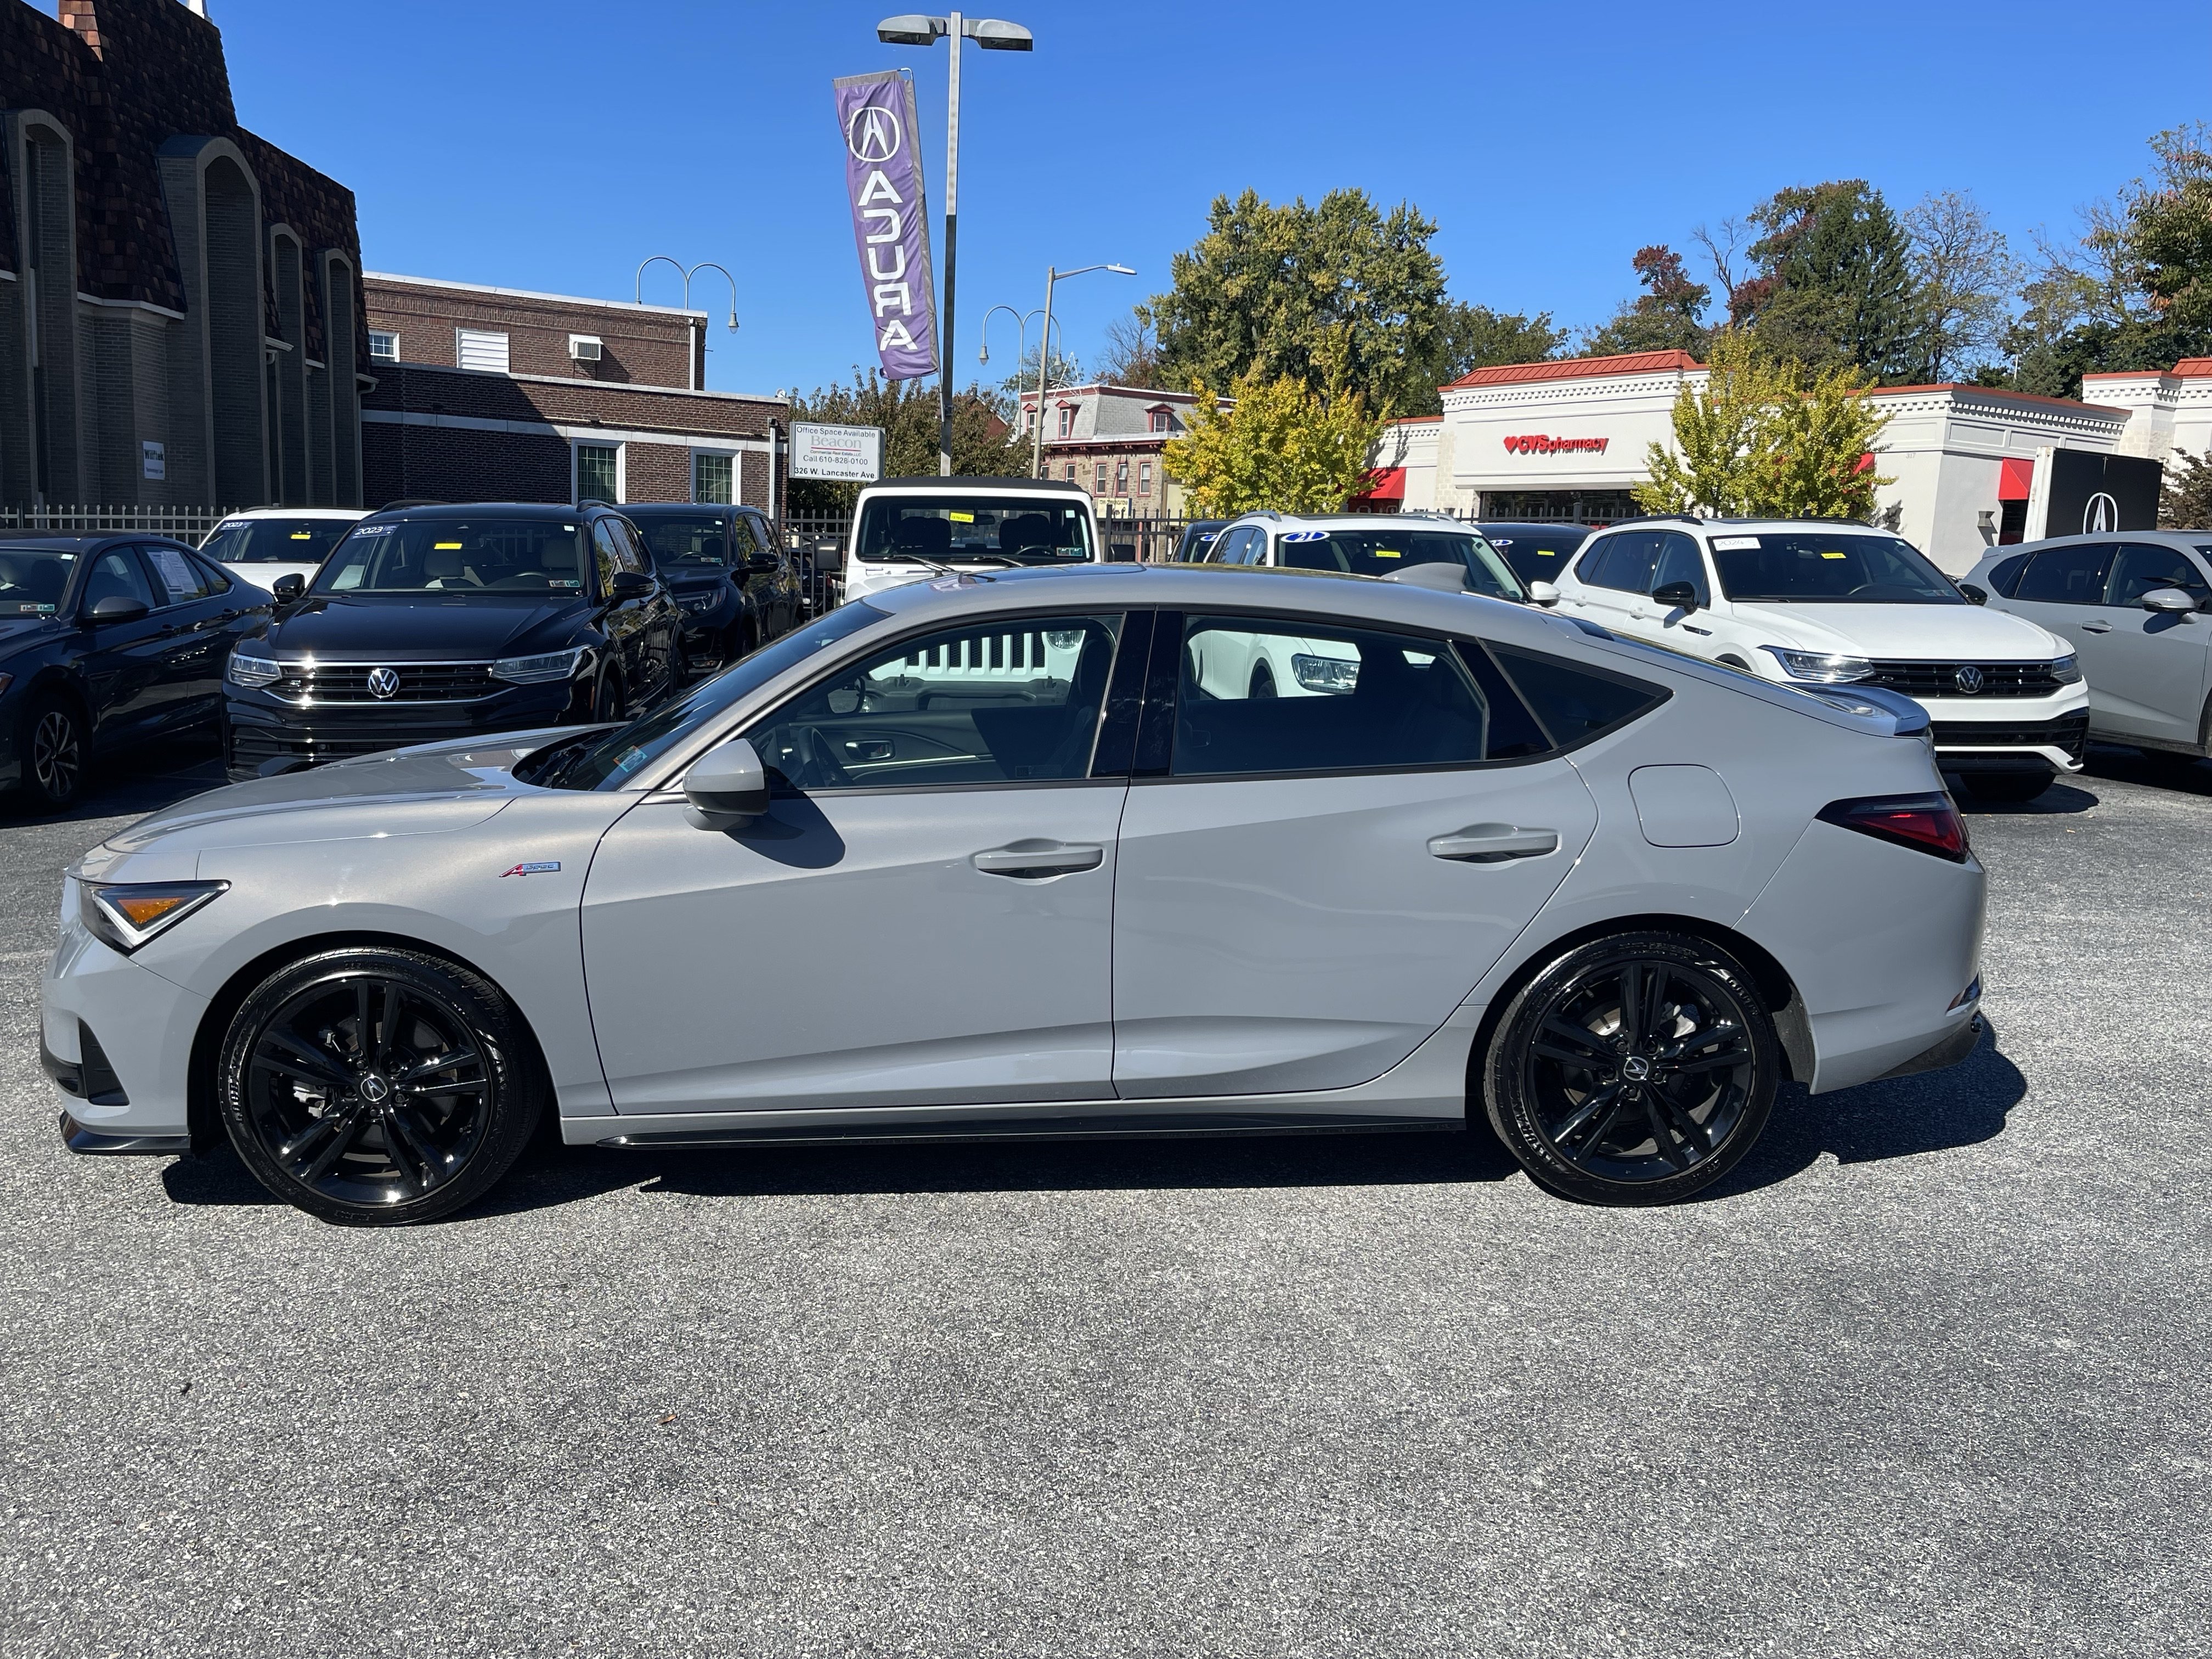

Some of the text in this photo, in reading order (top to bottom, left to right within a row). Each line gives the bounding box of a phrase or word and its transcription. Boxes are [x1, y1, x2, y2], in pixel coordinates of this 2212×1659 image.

[797, 426, 876, 438] Office Space Available
[811, 436, 862, 448] Beacon
[1517, 435, 1609, 453] CVS pharmacy
[819, 456, 868, 465] 610-828-0100
[822, 469, 859, 477] Lancaster
[355, 526, 383, 535] 2023
[1291, 531, 1316, 541] 21
